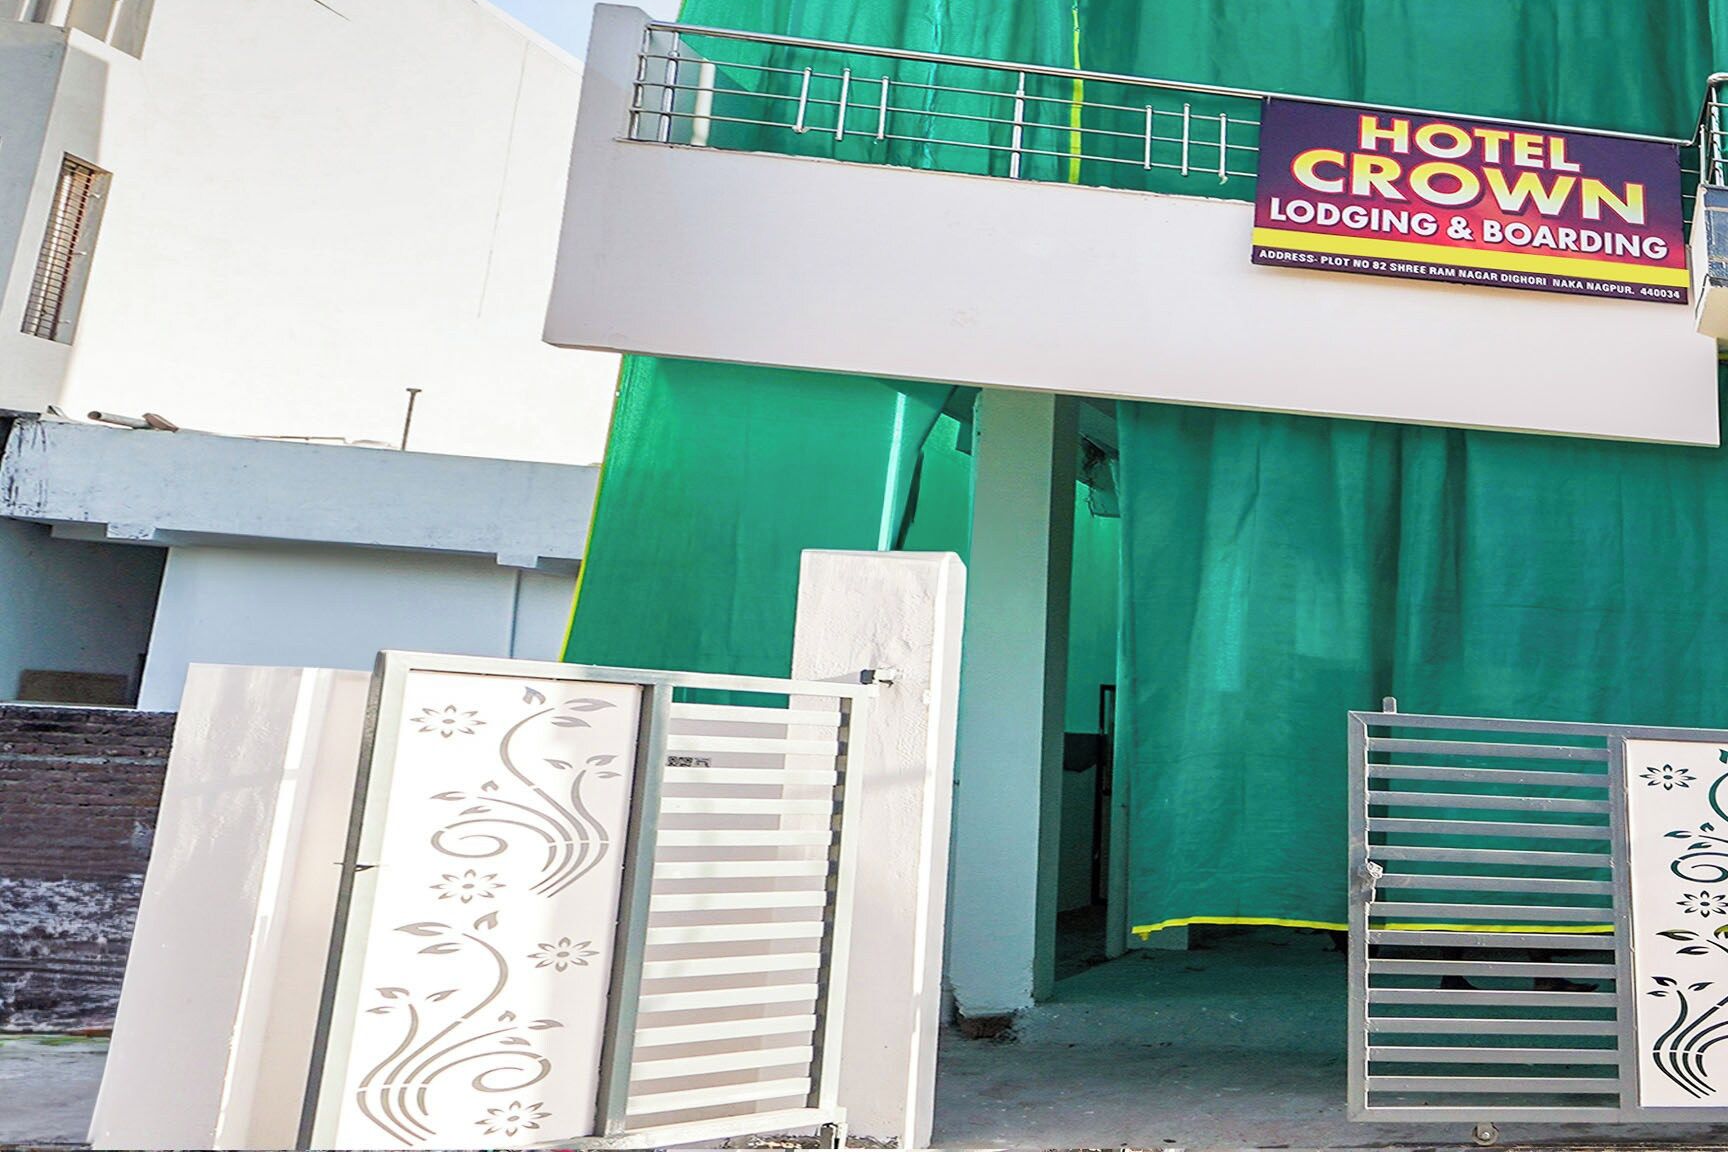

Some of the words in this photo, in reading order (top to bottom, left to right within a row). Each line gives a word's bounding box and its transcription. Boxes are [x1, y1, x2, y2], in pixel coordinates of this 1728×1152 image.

[1359, 115, 1581, 172] HOTEL
[1292, 149, 1647, 226] CROWN
[1270, 197, 1438, 236] LODGING
[1446, 217, 1474, 241] &
[1483, 219, 1668, 260] BOARDING
[1321, 256, 1350, 267] PLOT
[1353, 259, 1370, 269] NO
[1372, 261, 1387, 271] 82
[1390, 262, 1427, 275] SHREE
[1429, 266, 1456, 277] RAM
[1458, 269, 1498, 282] NAGAR
[1501, 273, 1547, 286] DIGHORI
[1552, 279, 1584, 290] NAKA
[1586, 282, 1635, 295] NAGPUR.
[1640, 287, 1680, 299] 440034
